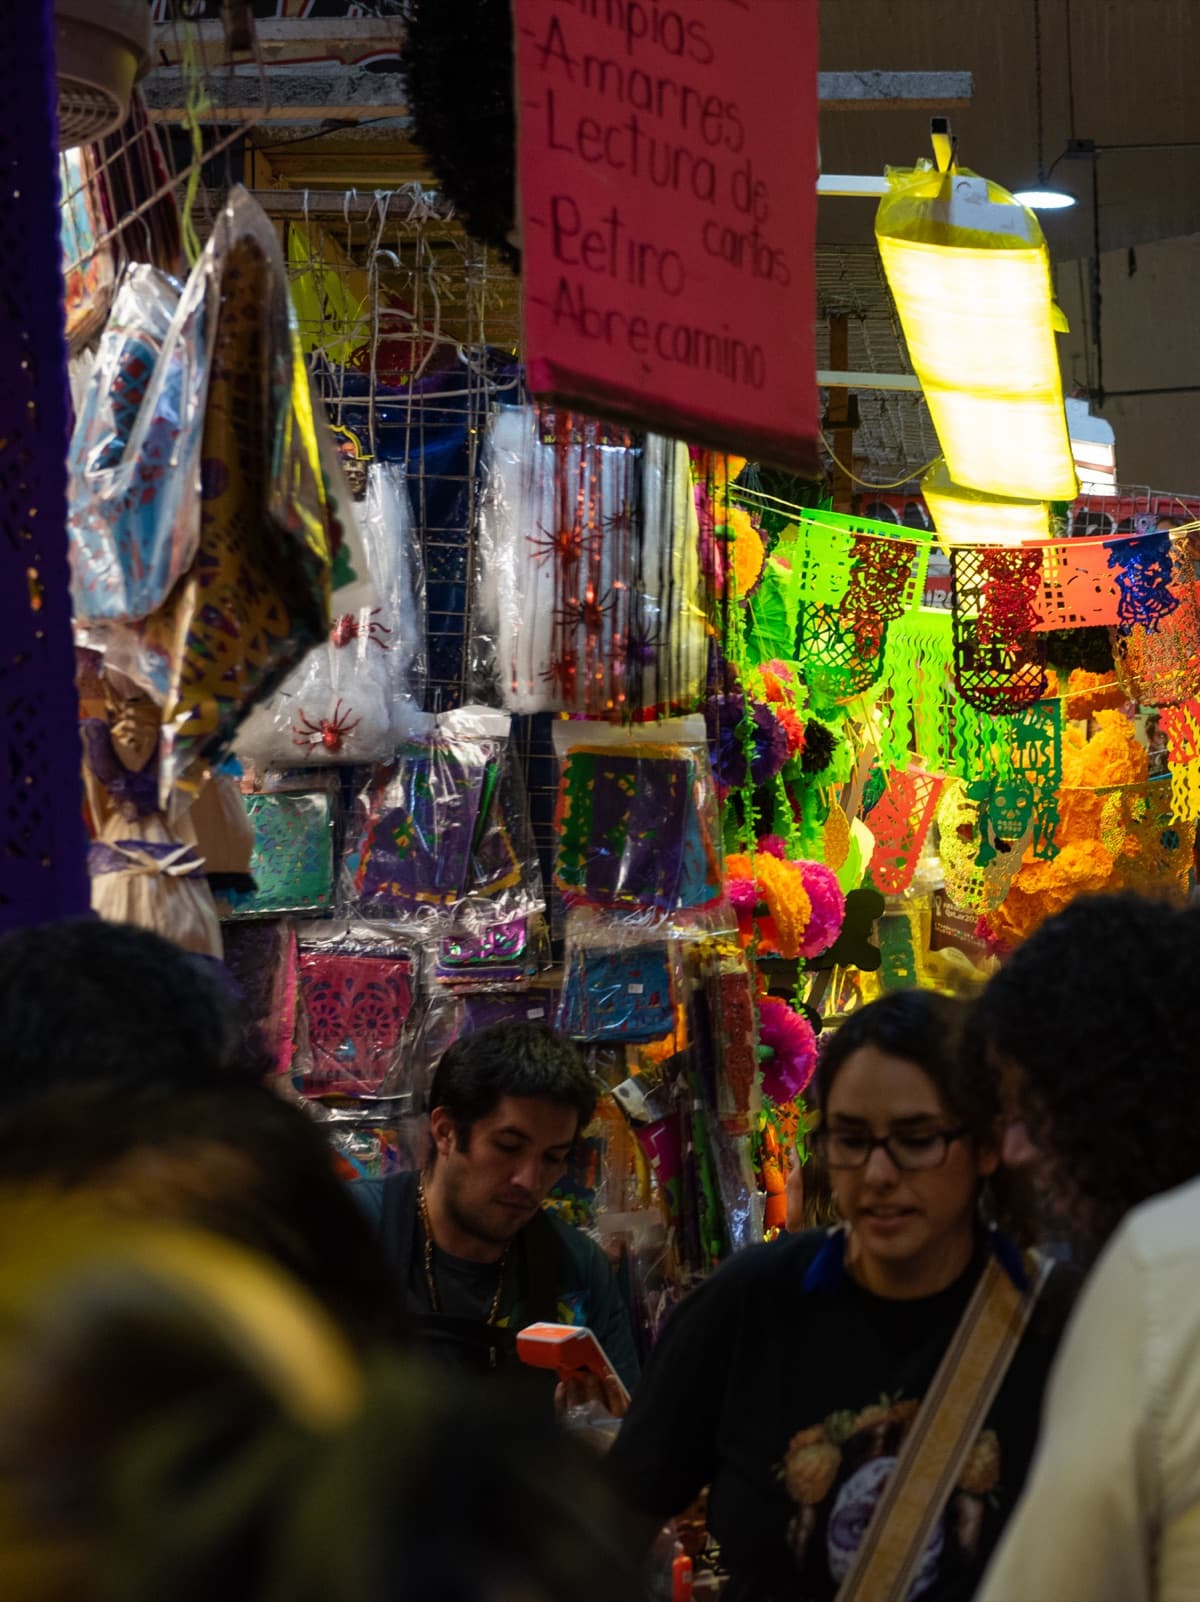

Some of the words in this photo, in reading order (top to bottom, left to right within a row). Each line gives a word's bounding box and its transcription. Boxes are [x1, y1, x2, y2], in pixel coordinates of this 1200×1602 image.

[553, 0, 714, 65] mpias
[731, 158, 768, 221] de
[702, 218, 791, 286] cartas
